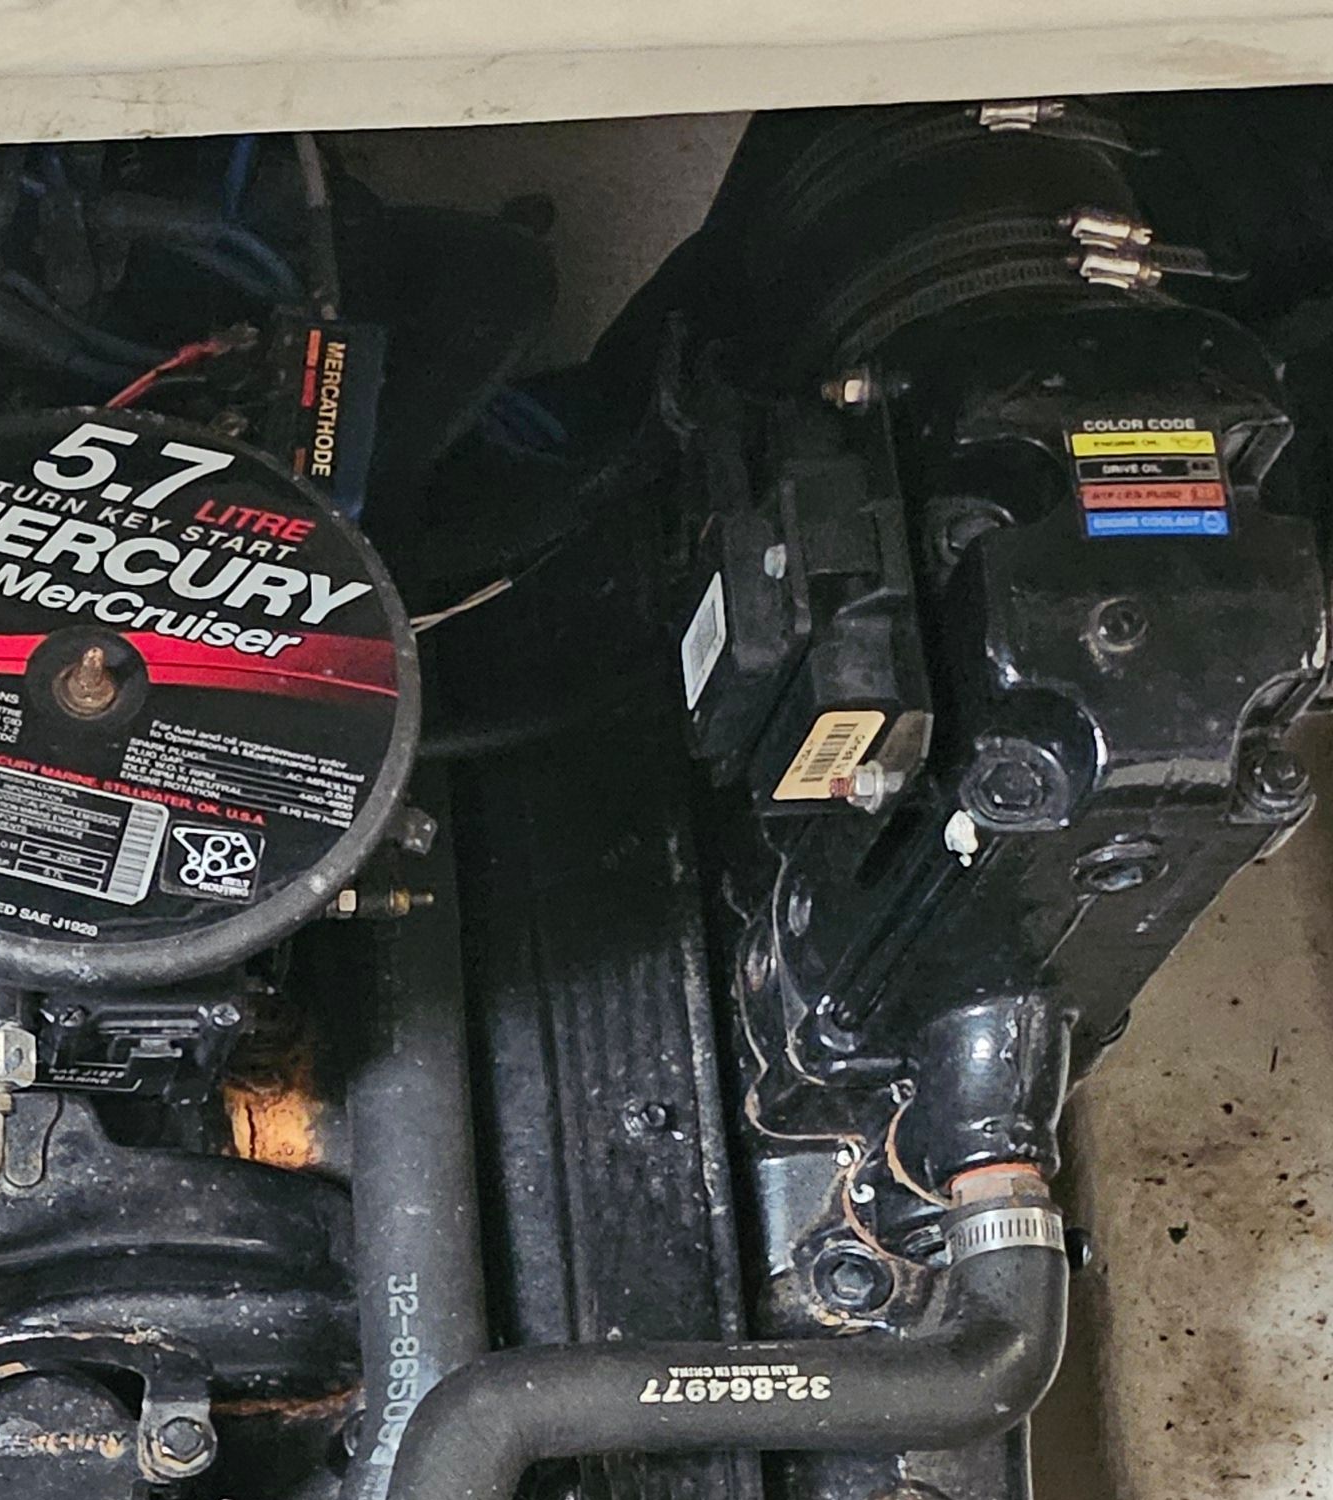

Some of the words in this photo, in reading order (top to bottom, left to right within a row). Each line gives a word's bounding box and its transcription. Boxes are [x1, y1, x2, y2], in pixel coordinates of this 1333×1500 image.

[311, 341, 346, 477] MERCATHODE
[1083, 418, 1144, 432] COLOR
[1147, 417, 1196, 430] CODE
[33, 422, 235, 510] 5.7
[1141, 463, 1162, 473] OIL
[96, 505, 174, 536] KEY
[180, 524, 297, 559] START
[193, 499, 316, 543] LITRE
[127, 745, 158, 759] PLUG
[129, 737, 166, 753] SPARK
[149, 728, 163, 739] to
[163, 730, 229, 756] Operations
[240, 747, 317, 775] Maintenance
[318, 765, 364, 784] Manual
[151, 719, 173, 732] For
[174, 724, 197, 737] fuel
[198, 729, 221, 743] and
[222, 735, 238, 746] oil
[238, 738, 316, 766] requirements
[121, 761, 147, 775] IDLE
[148, 767, 175, 781] RPM
[176, 773, 189, 784] IN
[189, 776, 242, 797] NEUTRAL
[124, 752, 152, 766] MAX.
[188, 767, 217, 782] RPM
[119, 769, 161, 787] ENGINE
[162, 779, 221, 801] ROTATION
[19, 906, 51, 926] SAE
[668, 1366, 714, 1377] CHINA
[714, 1365, 731, 1376] IN
[731, 1365, 770, 1376] MADE
[639, 1375, 831, 1403] 32-864977
